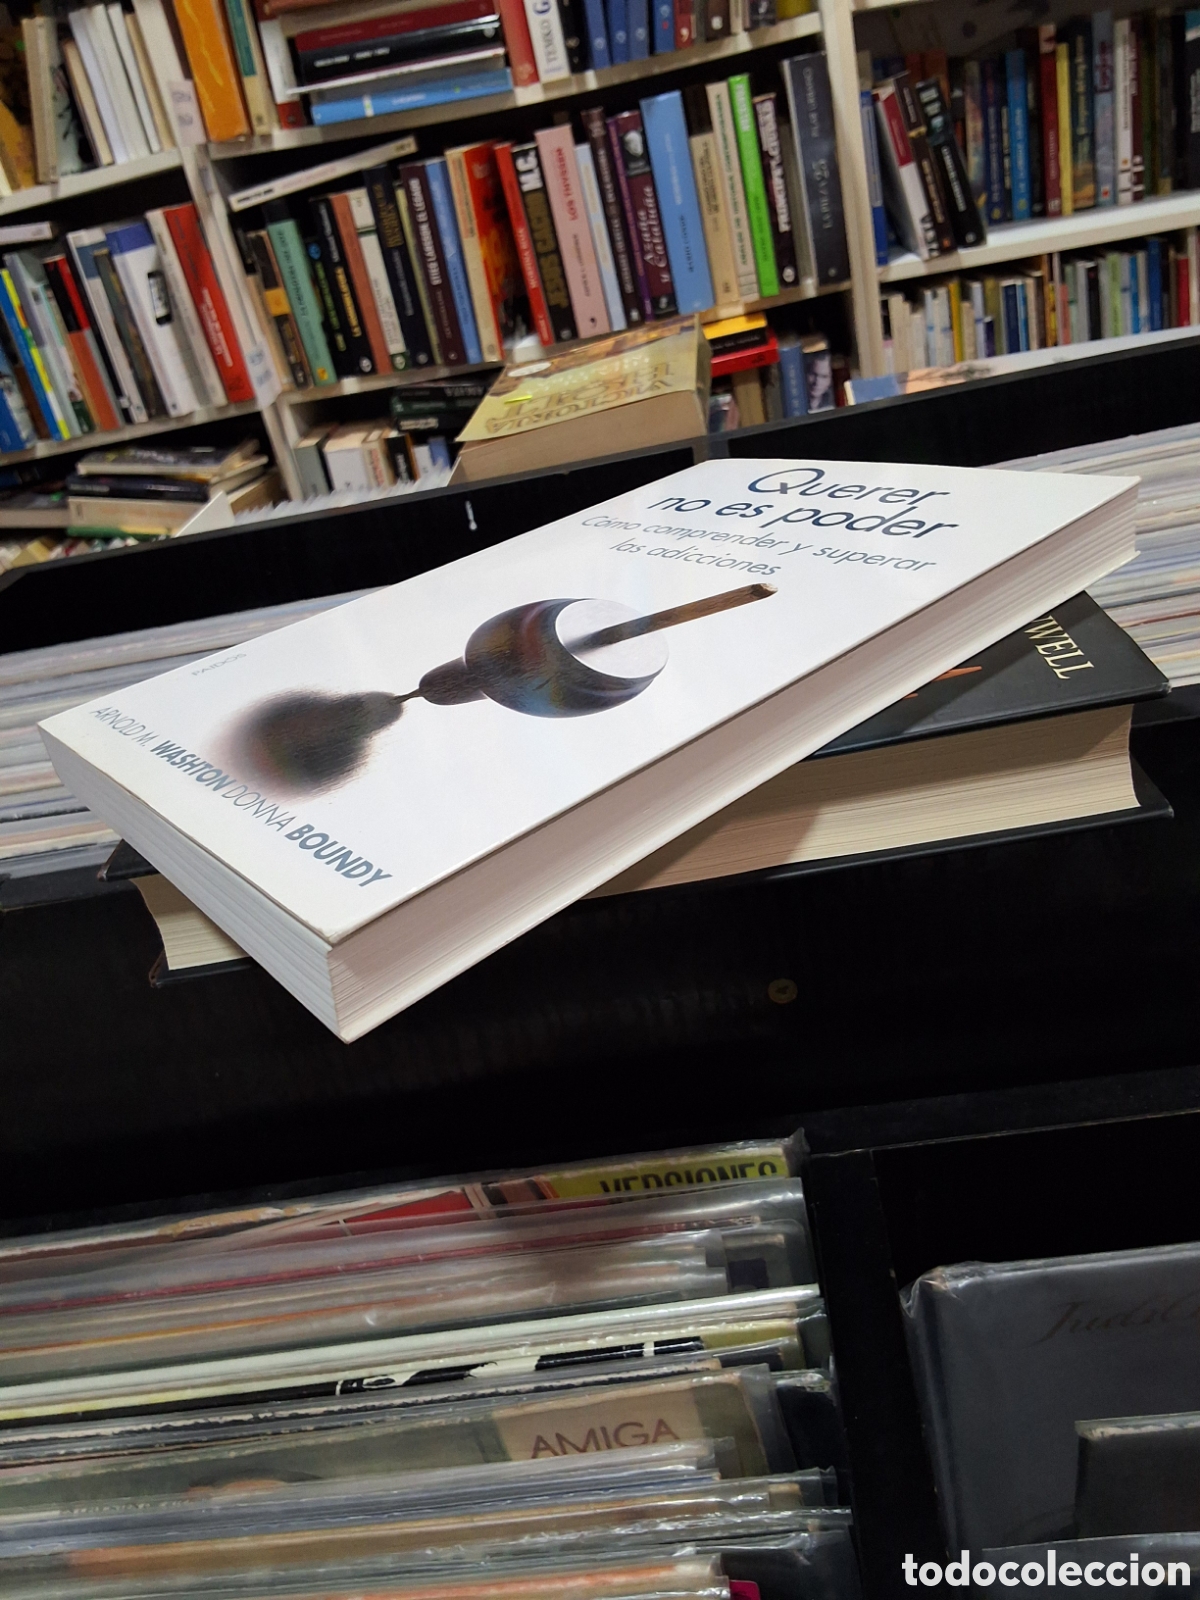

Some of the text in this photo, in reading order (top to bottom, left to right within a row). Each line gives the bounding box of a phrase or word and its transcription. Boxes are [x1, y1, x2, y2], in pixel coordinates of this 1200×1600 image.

[747, 467, 951, 506] Querer
[647, 495, 960, 539] no es poder
[580, 514, 937, 574] Cómo comprender y superar
[610, 538, 782, 577] las adicciones
[90, 705, 393, 888] ARNOLD M. WASHTON DONNA BOUNDY
[531, 1418, 680, 1459] AMIGA
